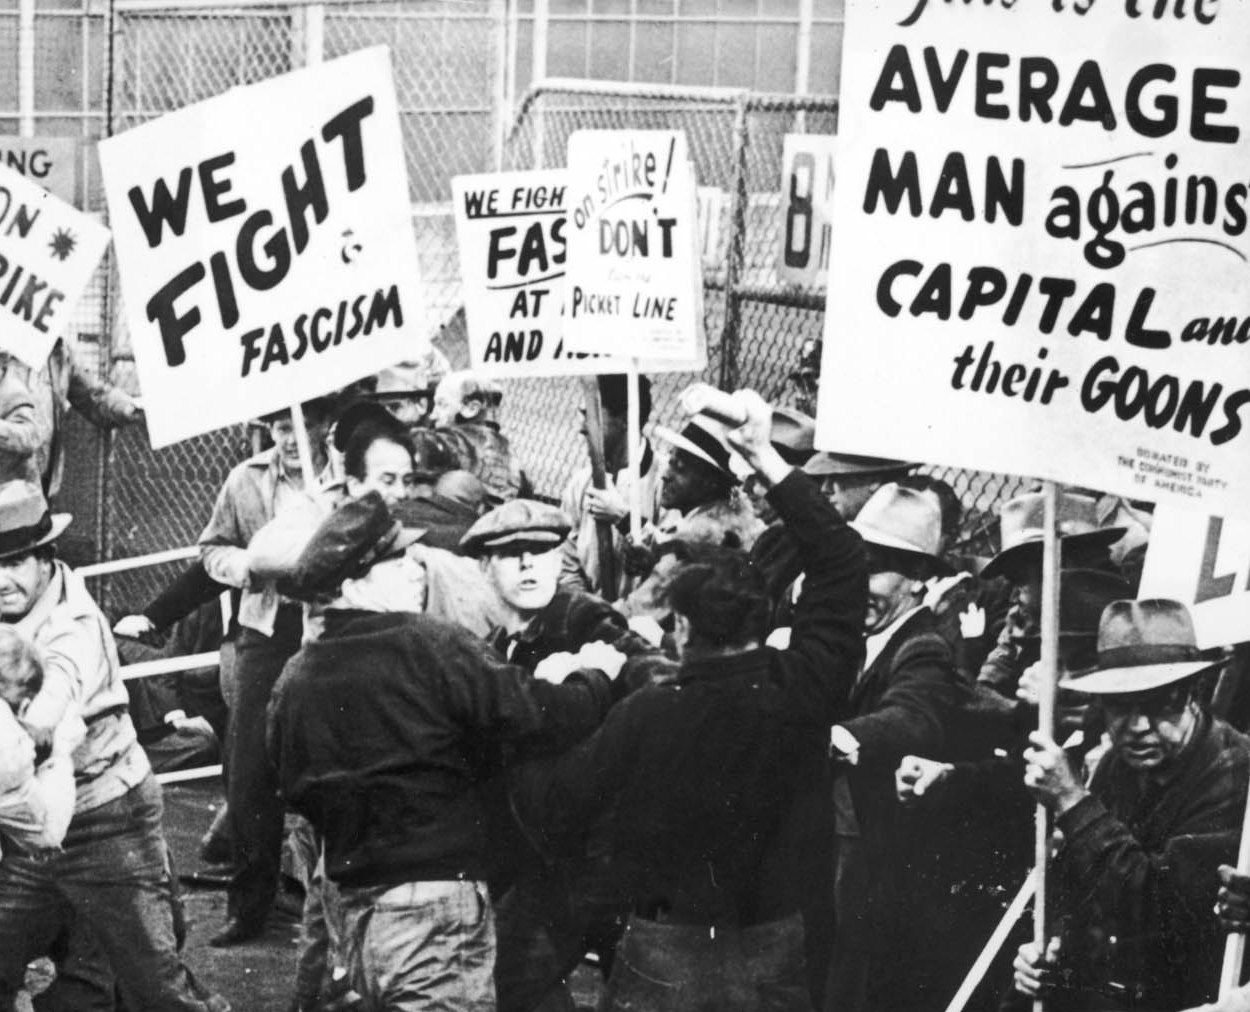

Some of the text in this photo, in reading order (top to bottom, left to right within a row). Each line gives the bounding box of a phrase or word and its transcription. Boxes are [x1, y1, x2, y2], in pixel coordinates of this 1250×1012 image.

[869, 44, 1241, 144] AVERAGE
[127, 150, 248, 248] WE
[145, 95, 376, 367] FIGHT
[464, 186, 567, 215] WE FIGH
[599, 208, 677, 258] DON'T
[862, 148, 1250, 270] MAN agains
[240, 284, 404, 378] FASCISM
[483, 329, 544, 363] AND
[509, 289, 550, 319] AT
[632, 293, 678, 321] LINE
[876, 258, 1172, 350] CAPITAL
[951, 341, 1250, 446] their GOONS
